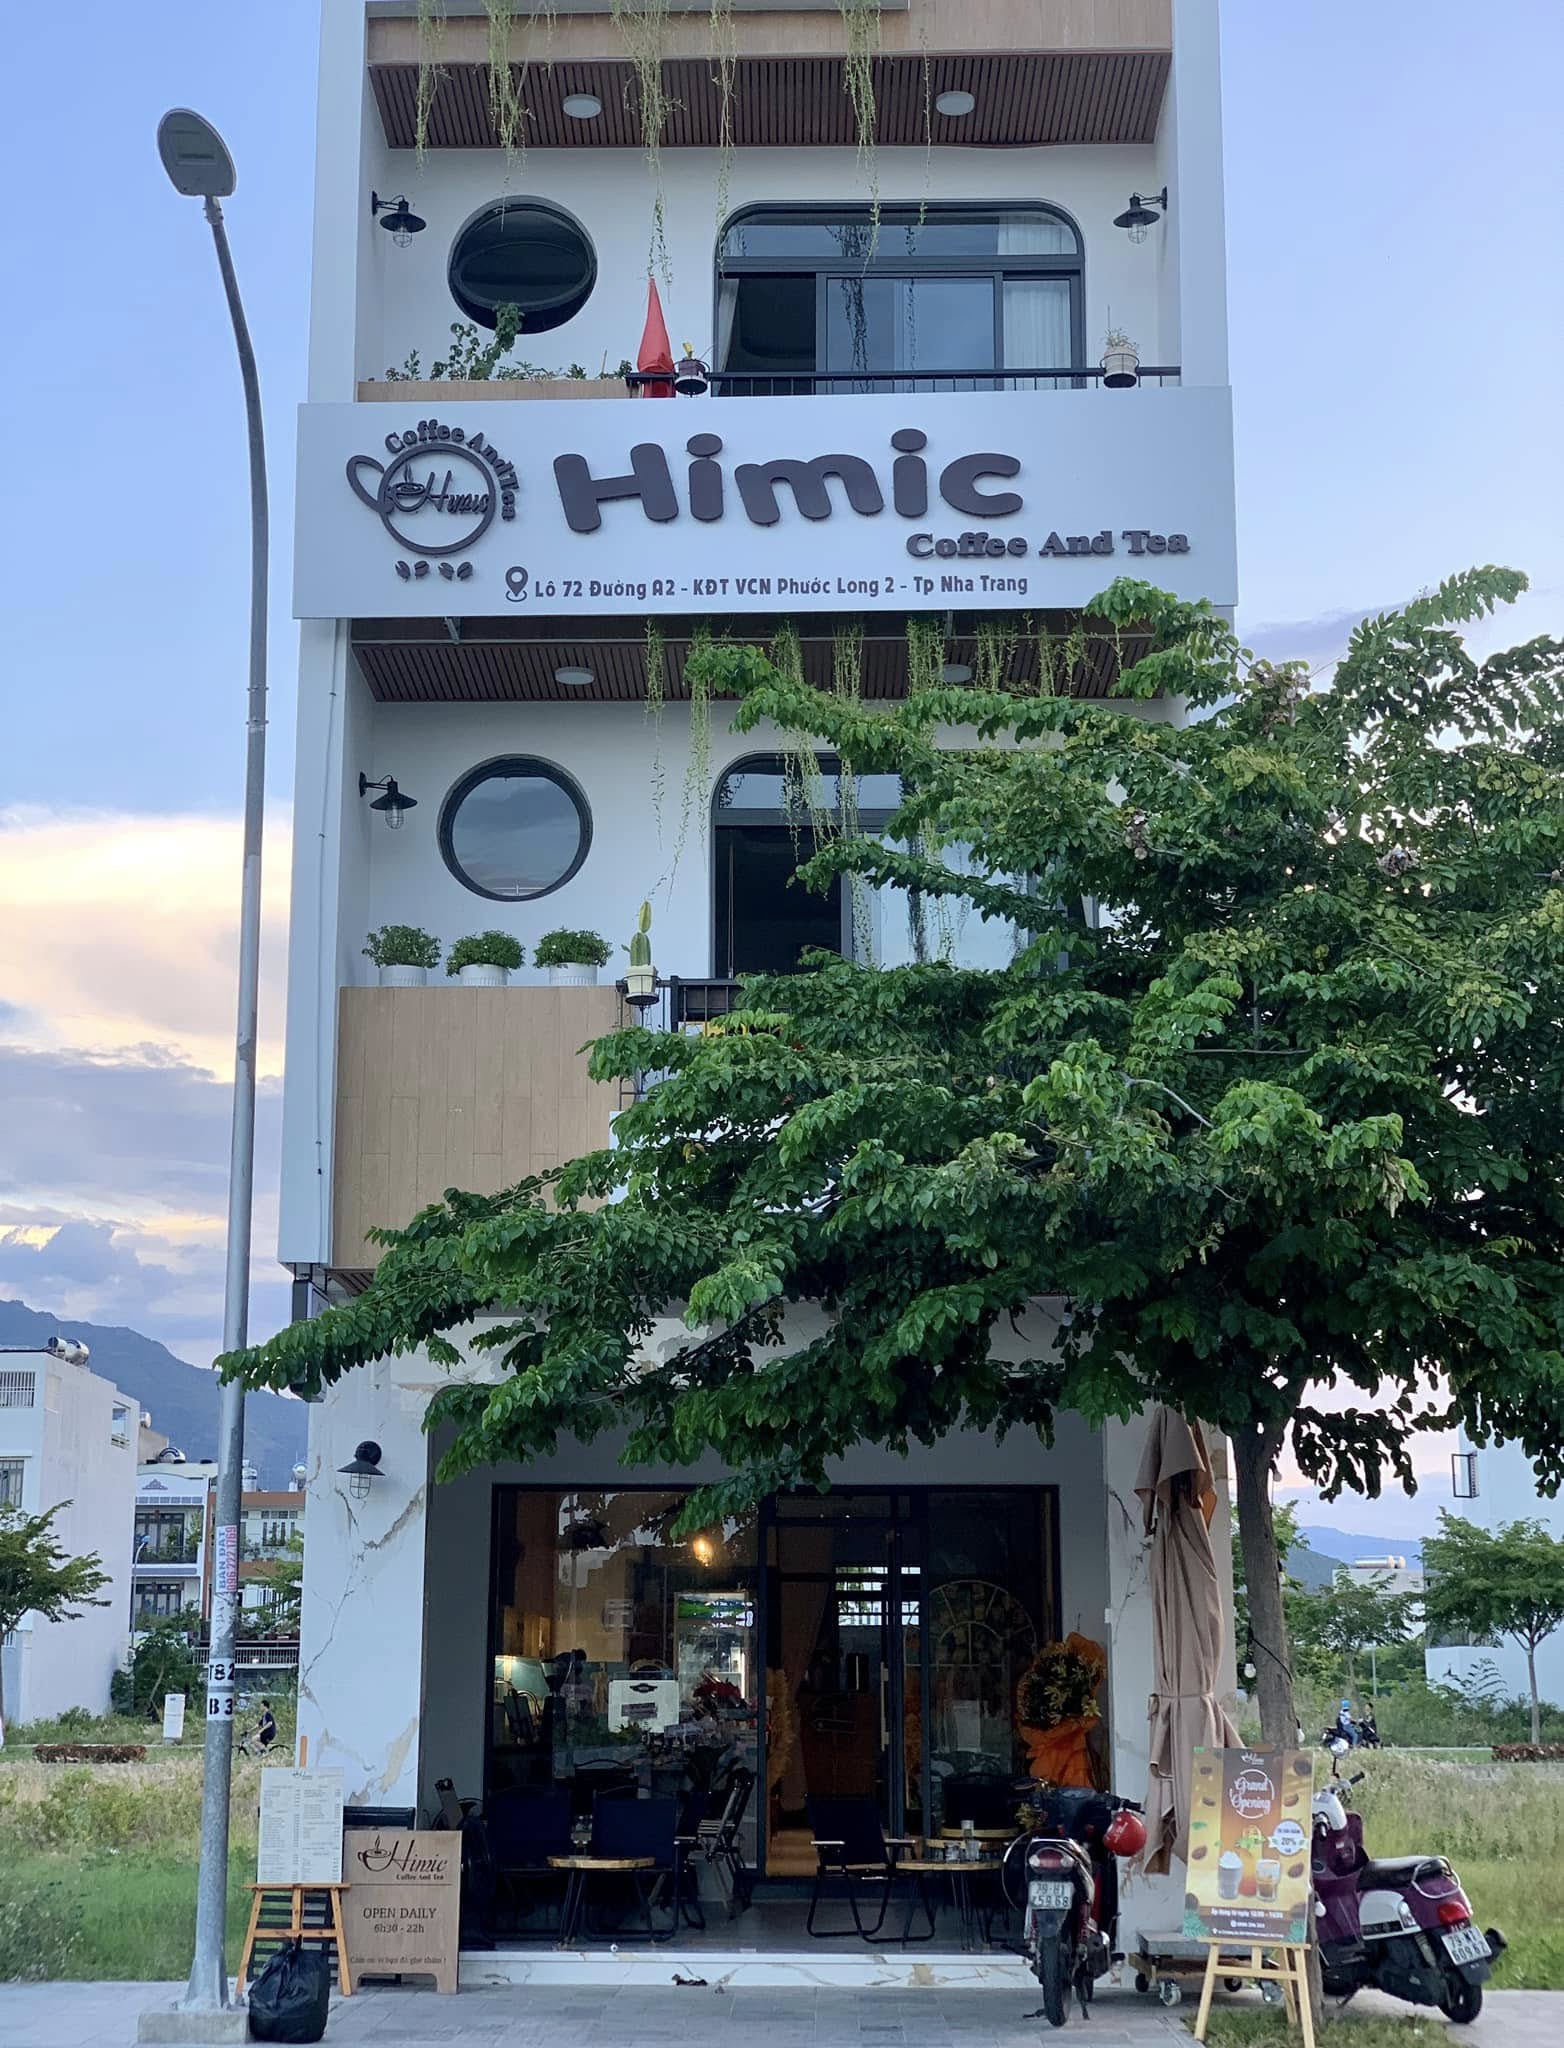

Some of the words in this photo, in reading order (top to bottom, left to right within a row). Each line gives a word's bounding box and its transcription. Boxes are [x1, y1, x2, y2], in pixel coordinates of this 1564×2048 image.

[385, 419, 464, 453] Coffee
[466, 432, 514, 479] And
[499, 470, 520, 521] Tea
[553, 428, 1023, 533] Himic
[906, 531, 1028, 557] Coffee
[1038, 531, 1115, 556] And
[1122, 530, 1191, 554] Tea
[535, 579, 556, 597] Lô
[562, 581, 583, 597] 72
[589, 579, 647, 600] Đường
[652, 579, 675, 596] A2
[693, 578, 729, 595] KĐT
[735, 578, 771, 595] VCN
[777, 577, 830, 594] Phước
[837, 577, 879, 597] Long
[885, 577, 894, 593] 2
[913, 576, 934, 595] Tp
[941, 576, 974, 593] Nha
[980, 575, 1028, 595] Trang
[1233, 1776, 1268, 1795] Grand
[1231, 1794, 1271, 1815] Opening
[389, 1839, 448, 1872] Himic
[363, 1907, 396, 1919] OPEN
[399, 1907, 437, 1919] DAILY
[374, 1923, 398, 1933] 6h30
[406, 1923, 424, 1933] 22h
